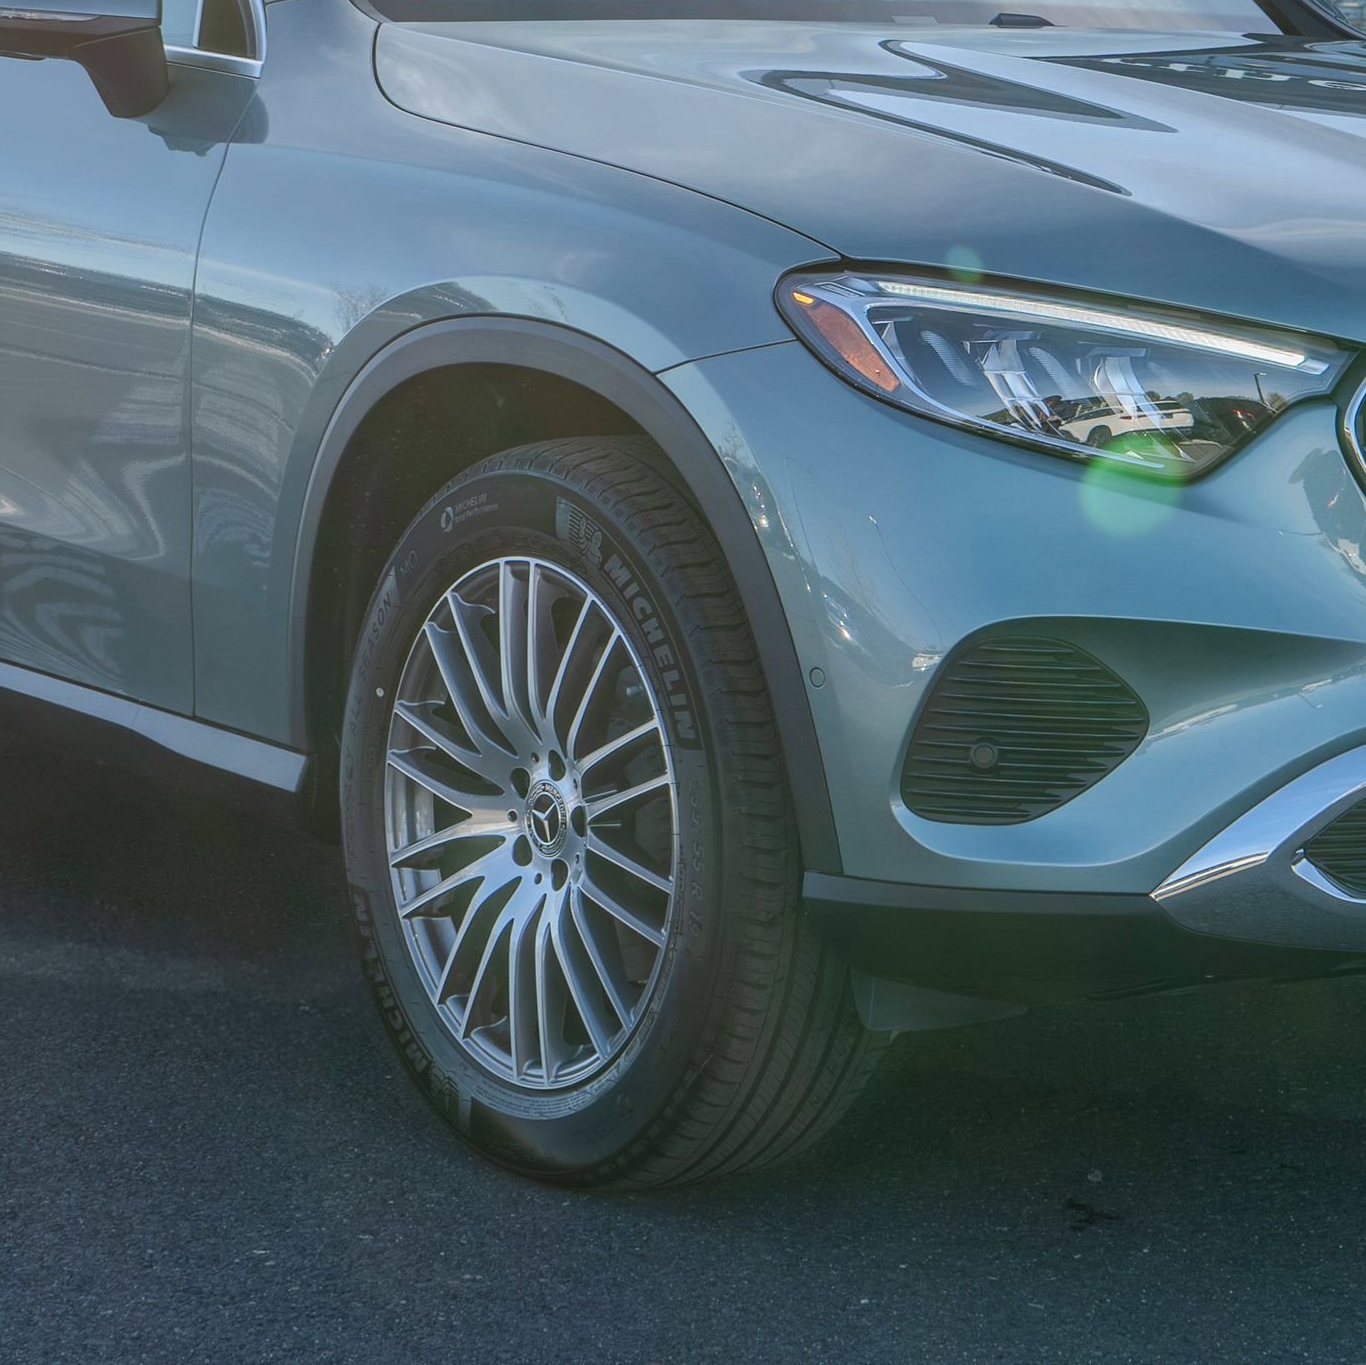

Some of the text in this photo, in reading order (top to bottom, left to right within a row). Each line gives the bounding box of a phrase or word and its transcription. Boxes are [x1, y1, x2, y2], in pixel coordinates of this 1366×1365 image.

[400, 550, 418, 579] MO
[359, 591, 393, 682] SEASON
[603, 553, 697, 740] MICHELIN
[690, 882, 704, 901] R
